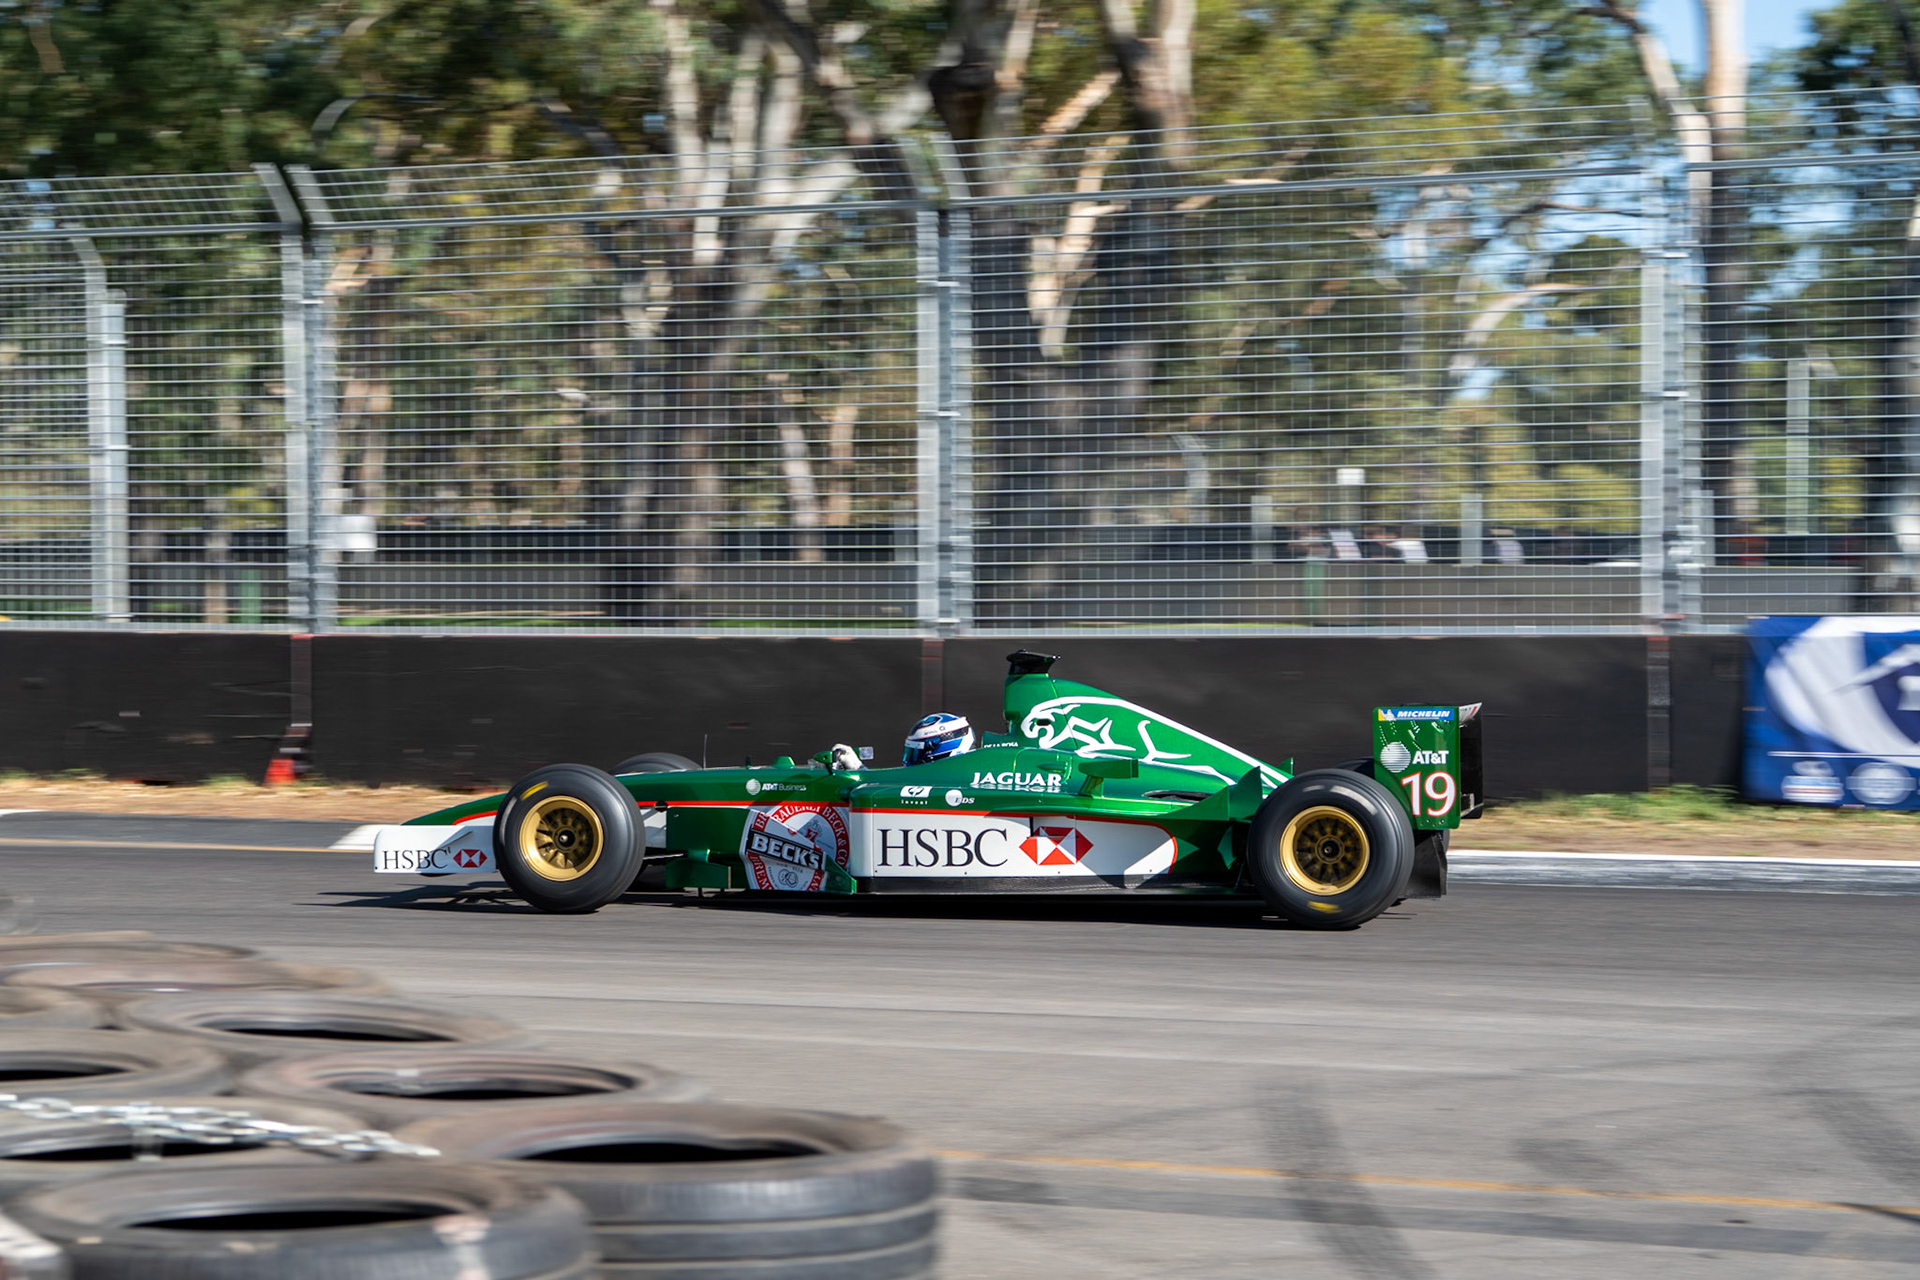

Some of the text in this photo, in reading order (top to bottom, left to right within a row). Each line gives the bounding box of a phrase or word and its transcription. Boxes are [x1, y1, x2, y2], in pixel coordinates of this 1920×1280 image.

[1412, 750, 1449, 764] AT&T
[779, 783, 806, 791] Business
[970, 772, 1062, 787] JAGUAR
[1401, 771, 1457, 817] 19
[383, 848, 449, 870] HSBC
[751, 833, 820, 870] BECK'S
[877, 828, 1008, 868] HSBC
